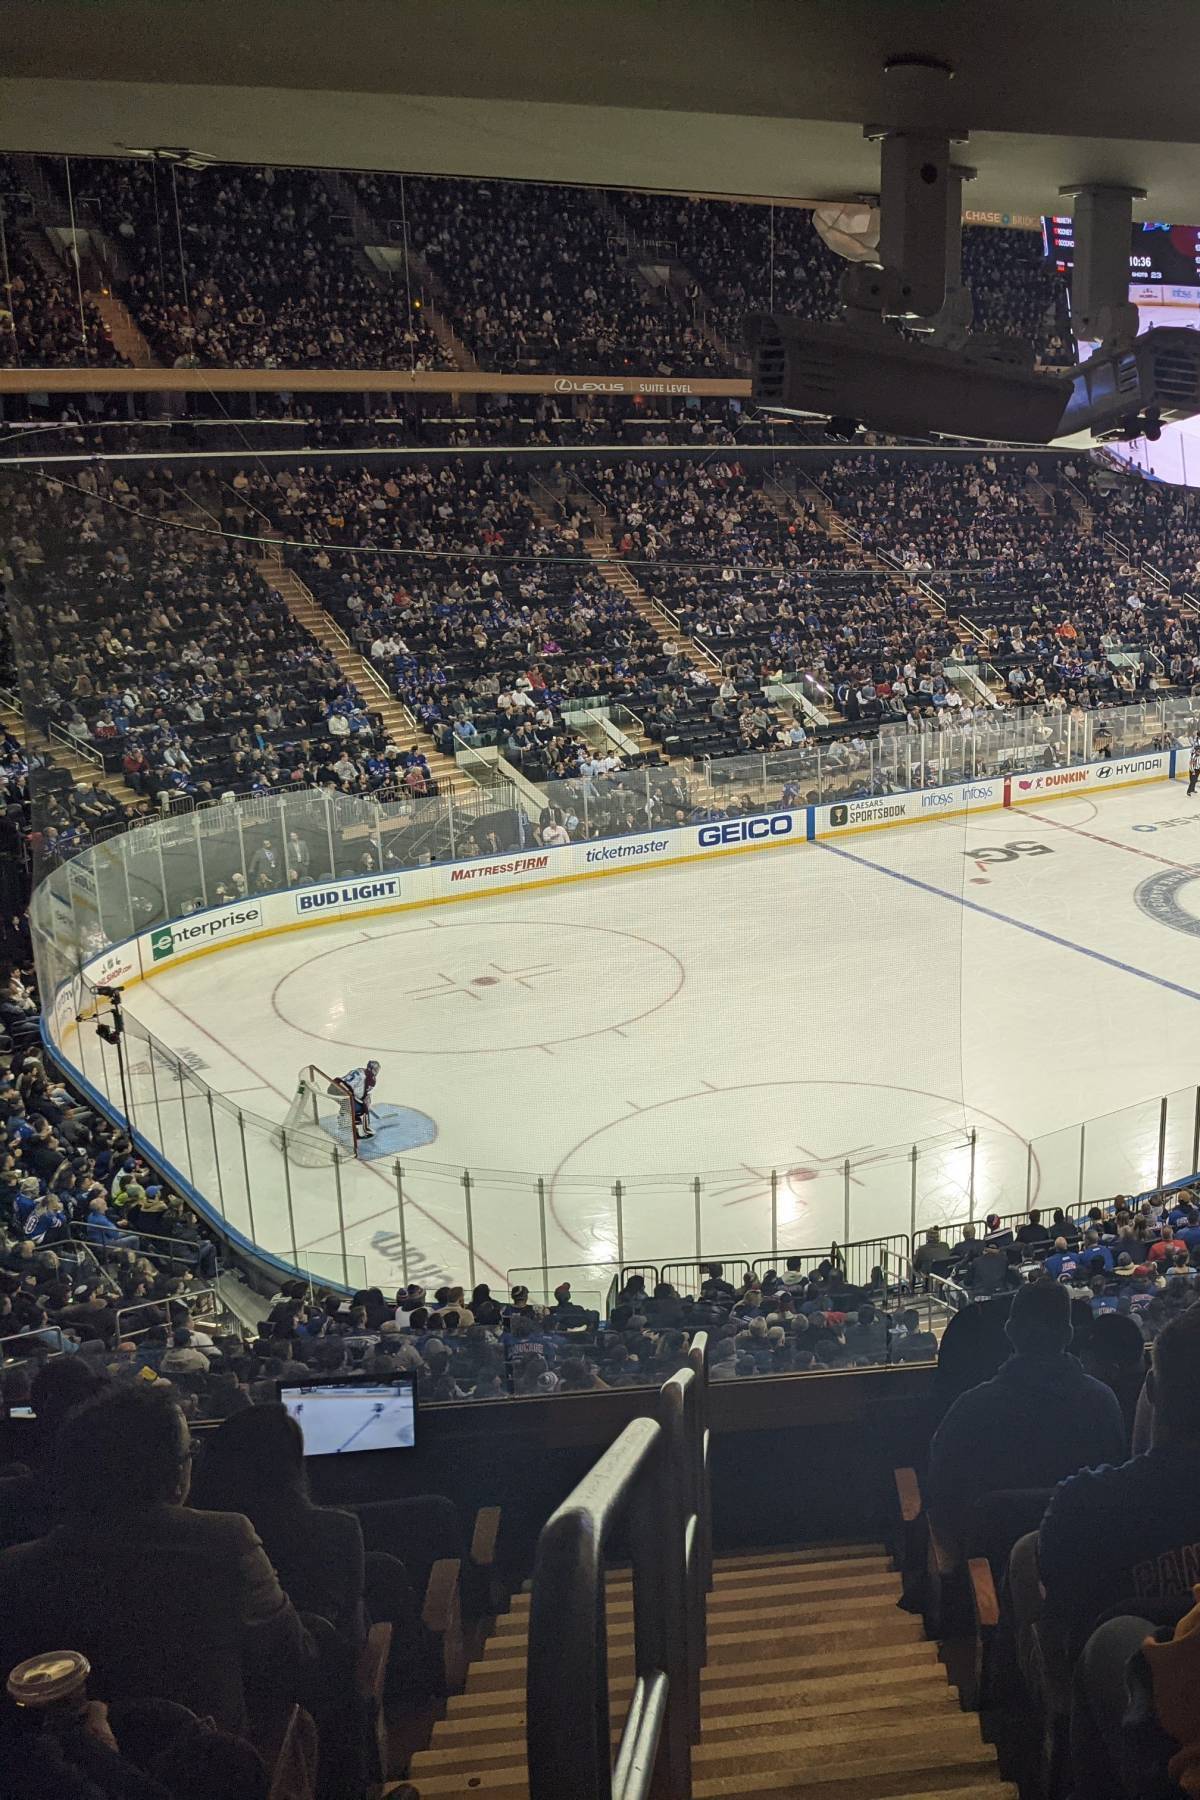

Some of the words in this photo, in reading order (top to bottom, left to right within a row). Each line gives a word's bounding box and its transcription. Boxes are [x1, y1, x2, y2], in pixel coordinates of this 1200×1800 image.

[965, 210, 1000, 222] CHASE
[1129, 256, 1152, 268] 10:36
[574, 382, 624, 392] LEXUS
[639, 383, 663, 392] SUITE
[666, 384, 692, 394] LEVEL
[1116, 759, 1162, 775] HYUNDAI
[1045, 770, 1090, 788] DUNKIN'
[921, 791, 954, 808] Infosys
[962, 785, 993, 802] Infosys
[850, 800, 884, 811] CAESARS
[850, 805, 906, 824] SPORTSBOOK
[698, 815, 792, 847] GEICO
[586, 838, 669, 862] ticketmaster
[300, 891, 340, 911] BUD
[342, 881, 396, 902] LIGHT
[154, 908, 260, 950] enterprise
